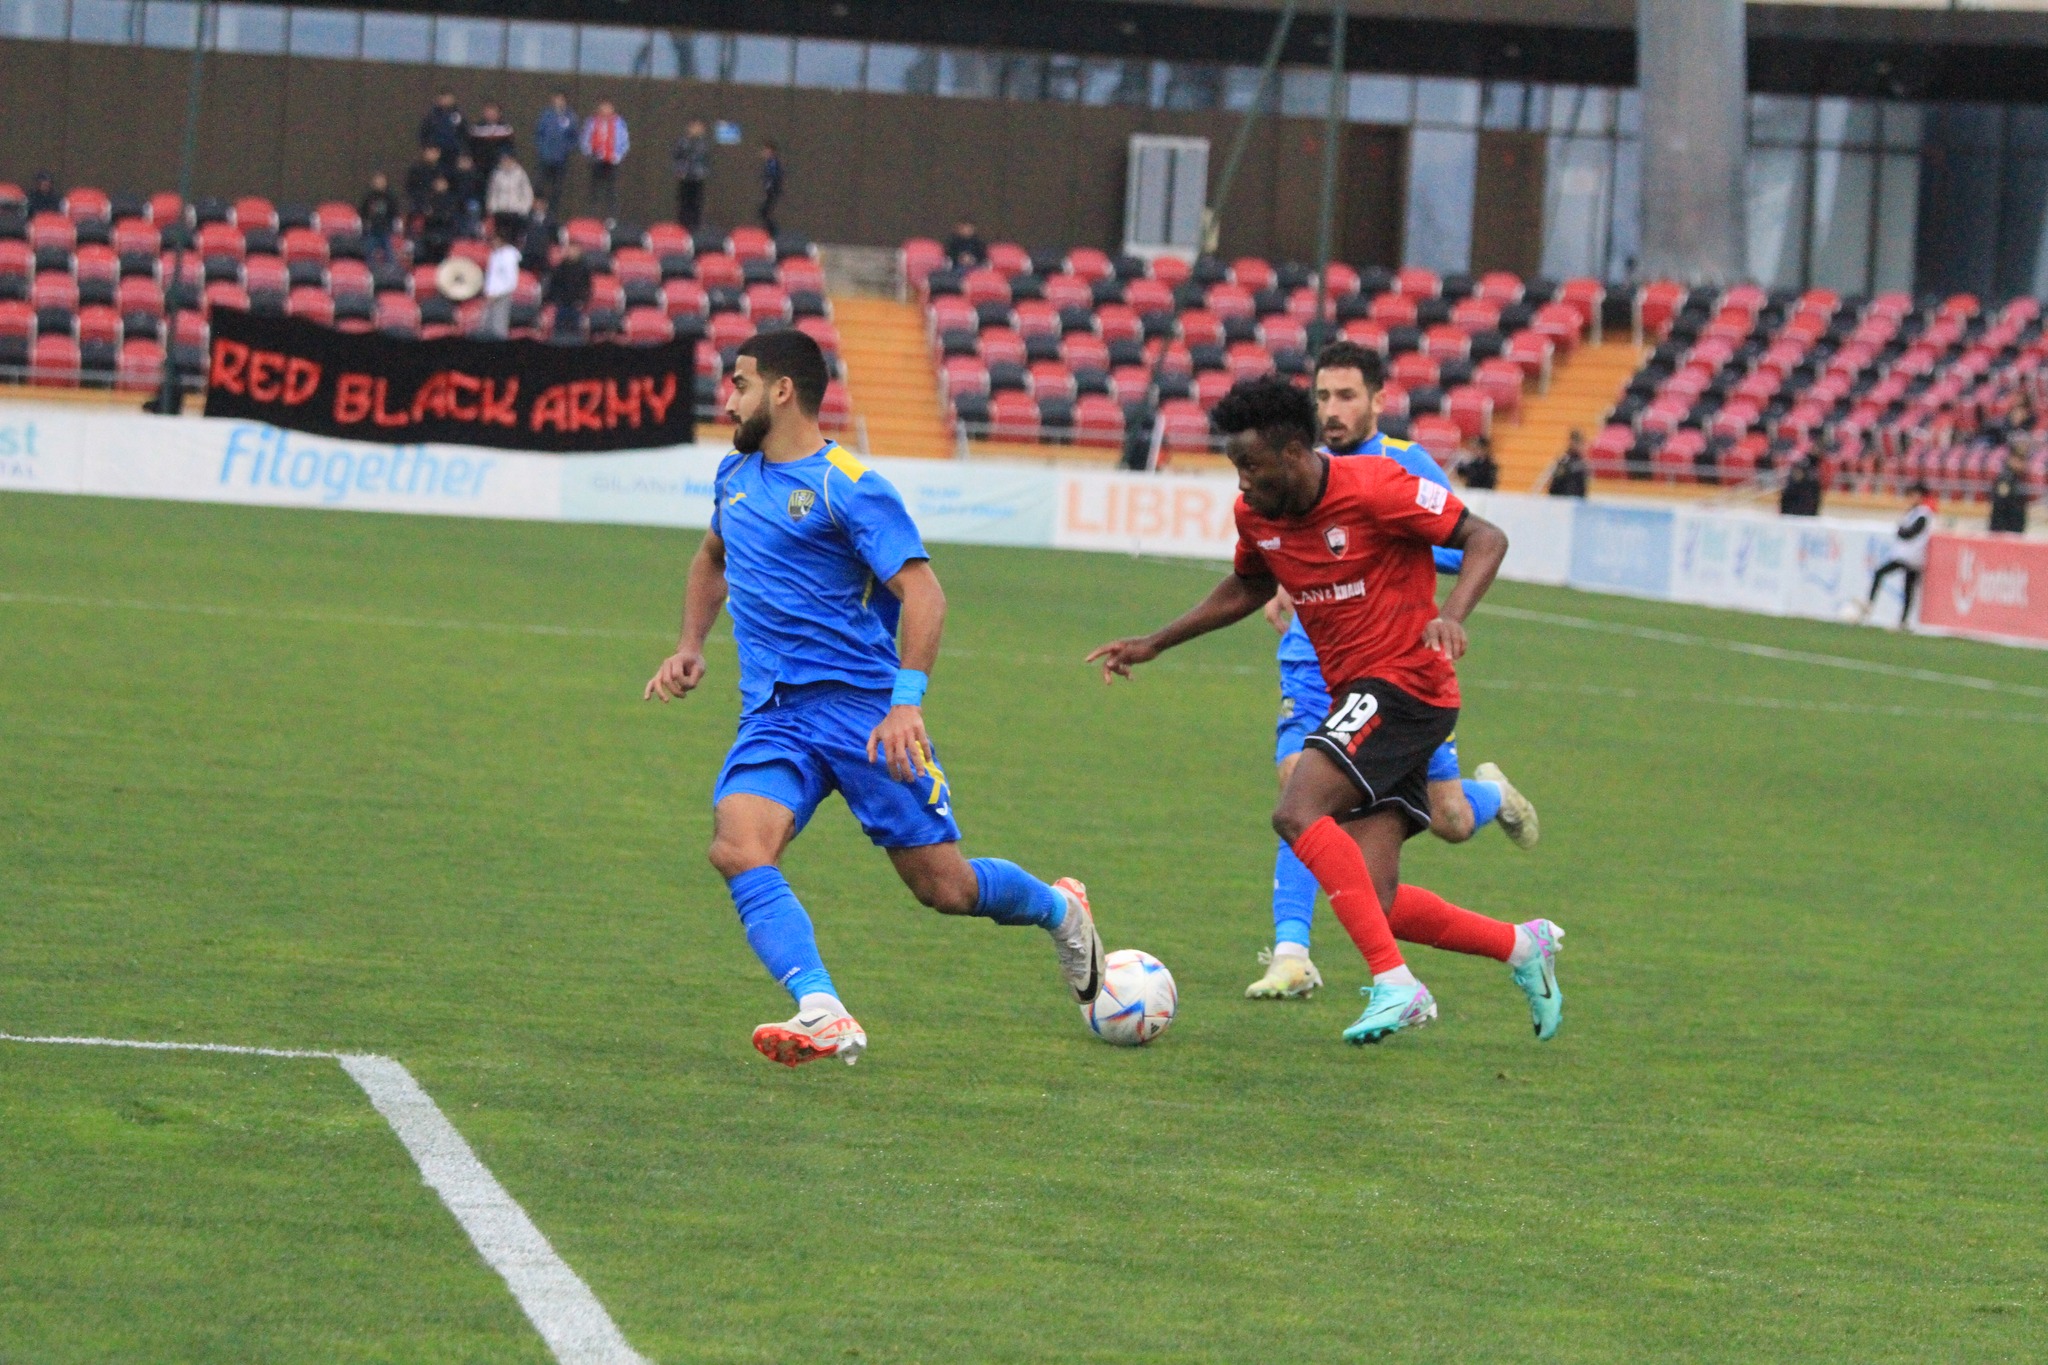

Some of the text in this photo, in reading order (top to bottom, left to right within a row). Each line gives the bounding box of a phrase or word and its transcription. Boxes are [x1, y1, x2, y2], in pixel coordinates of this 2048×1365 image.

[209, 338, 677, 432] RED BLACK ARMY
[219, 424, 496, 501] Fitogether
[1325, 692, 1378, 732] 19
